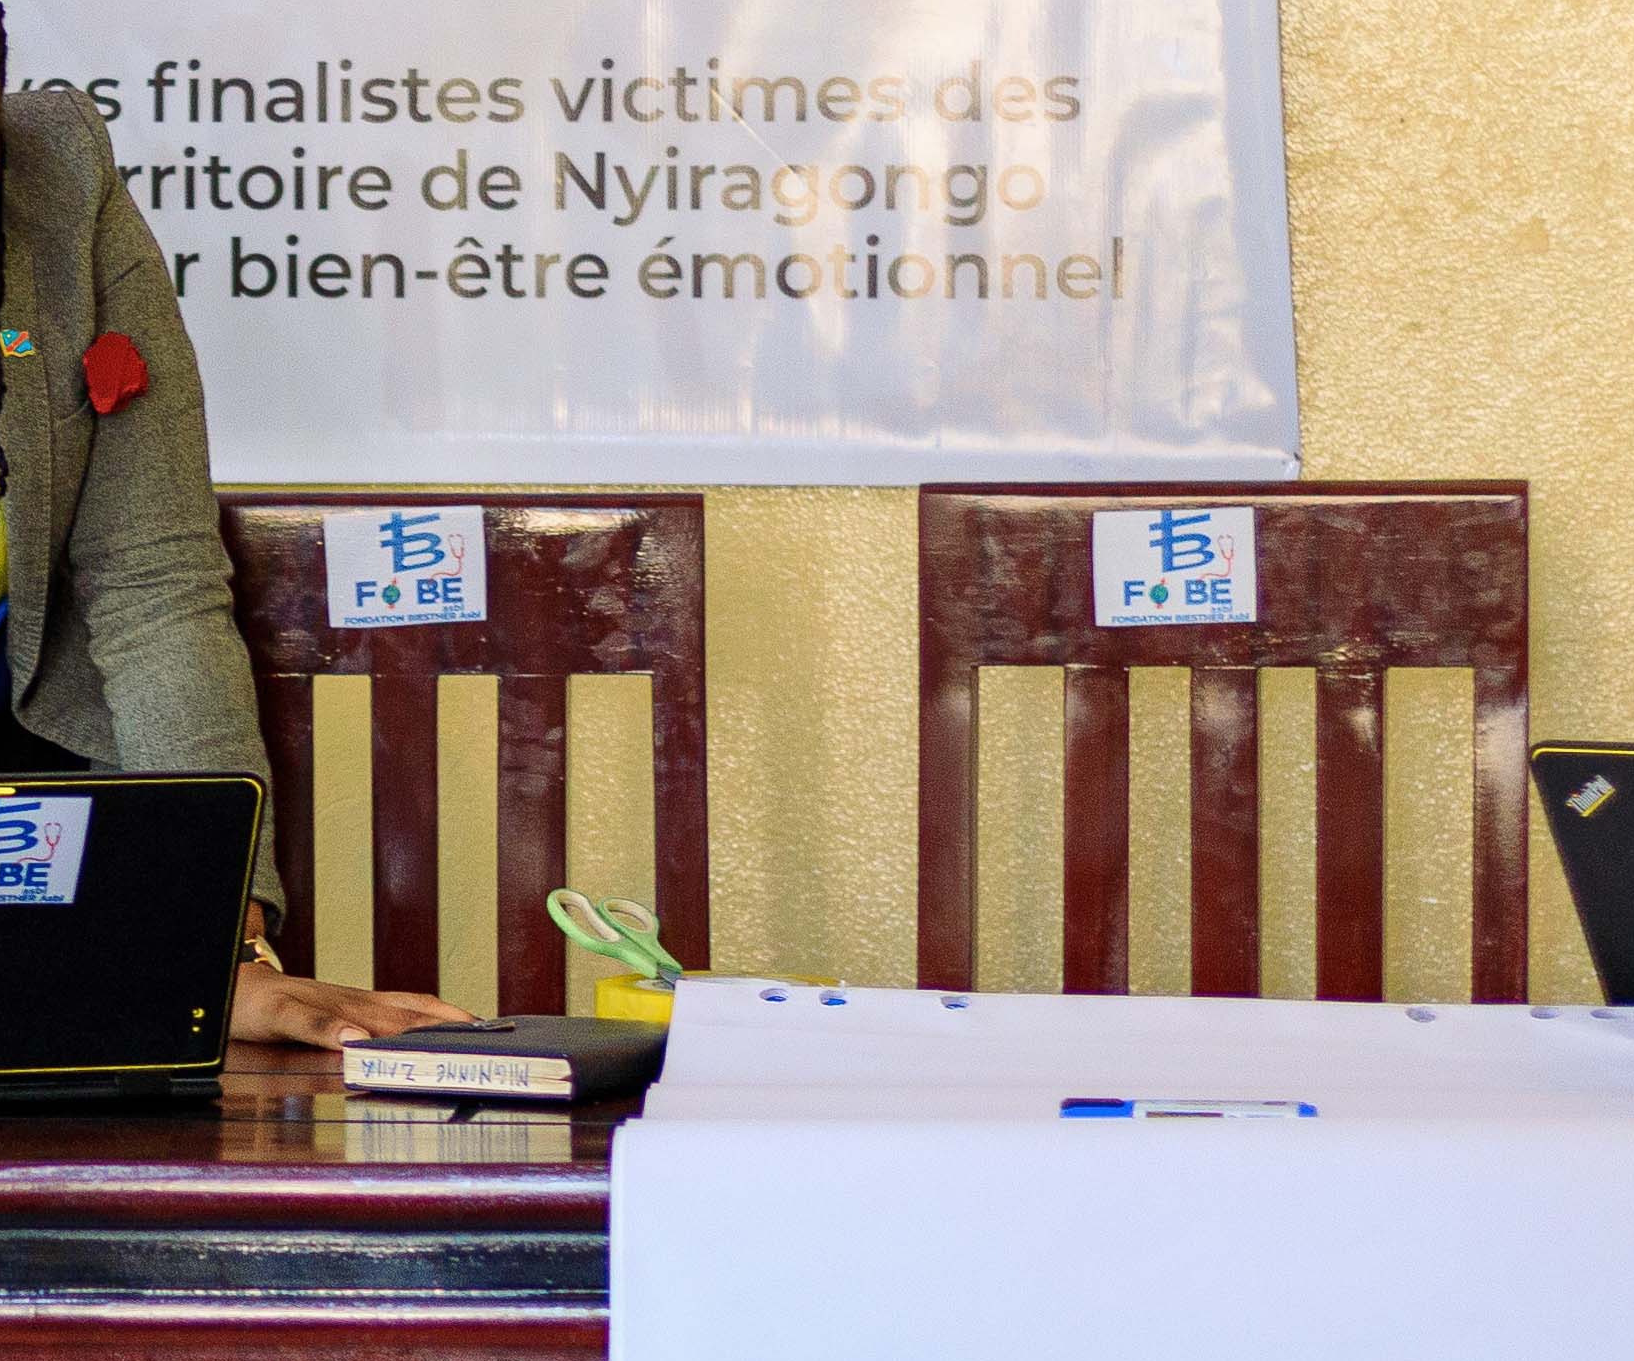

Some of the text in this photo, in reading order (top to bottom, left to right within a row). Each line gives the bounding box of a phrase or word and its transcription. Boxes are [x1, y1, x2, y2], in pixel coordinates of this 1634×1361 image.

[147, 59, 525, 124] finalistes
[550, 57, 907, 124] victimes
[933, 58, 1082, 123] des
[420, 148, 522, 211] de
[553, 145, 1045, 227] Nyiragongo
[230, 234, 610, 299] bien-être
[637, 234, 1125, 300] émotionnel
